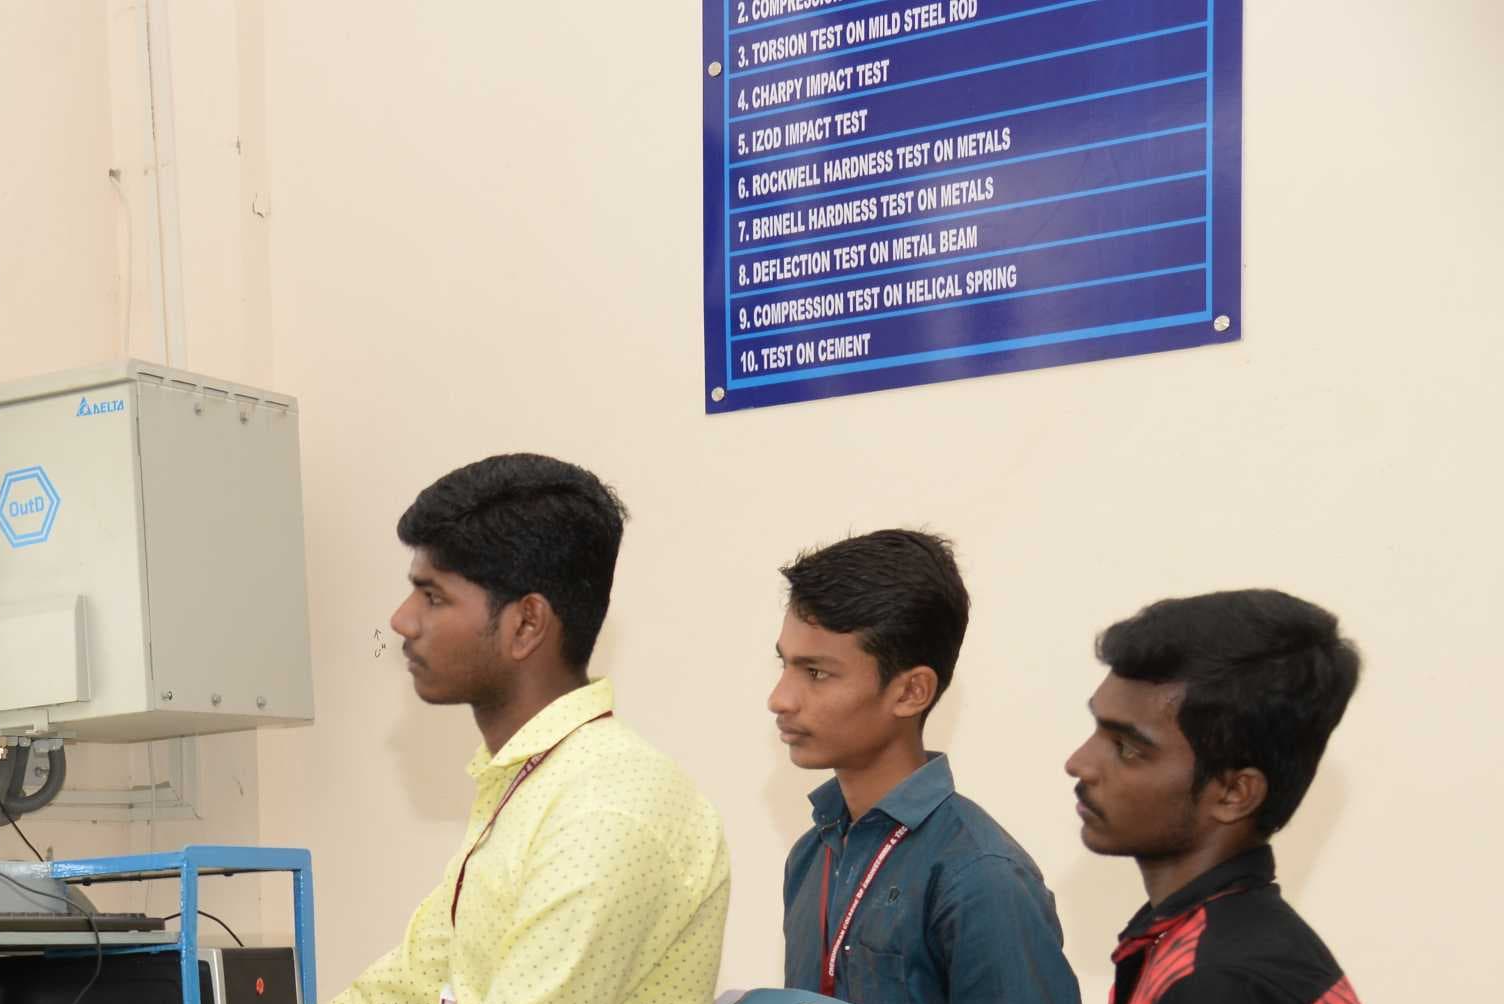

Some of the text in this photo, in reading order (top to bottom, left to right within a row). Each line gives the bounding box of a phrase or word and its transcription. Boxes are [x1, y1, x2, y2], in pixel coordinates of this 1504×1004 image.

[737, 0, 842, 24] 2. COMPRES
[738, 0, 977, 67] 3. TORSION TEST ON MILD STEEL ROD
[737, 59, 890, 112] 4. CHARPY IMPACT TEST
[737, 110, 868, 155] 5. IZOD IMPACT TEST
[738, 127, 1011, 199] 6. ROCKWELL HARDNESS TEST ON METALS
[738, 176, 994, 243] 7. BRINELL HARDNESS TEST ON METALS
[739, 225, 978, 287] 8. DEFLECTION TEST ON METAL BEAM
[739, 264, 1017, 330] 9. COMPRESSION TEST ON HELICAL SPRING
[740, 332, 871, 373] 10. TEST ON CEMENT
[9, 496, 45, 517] OutD
